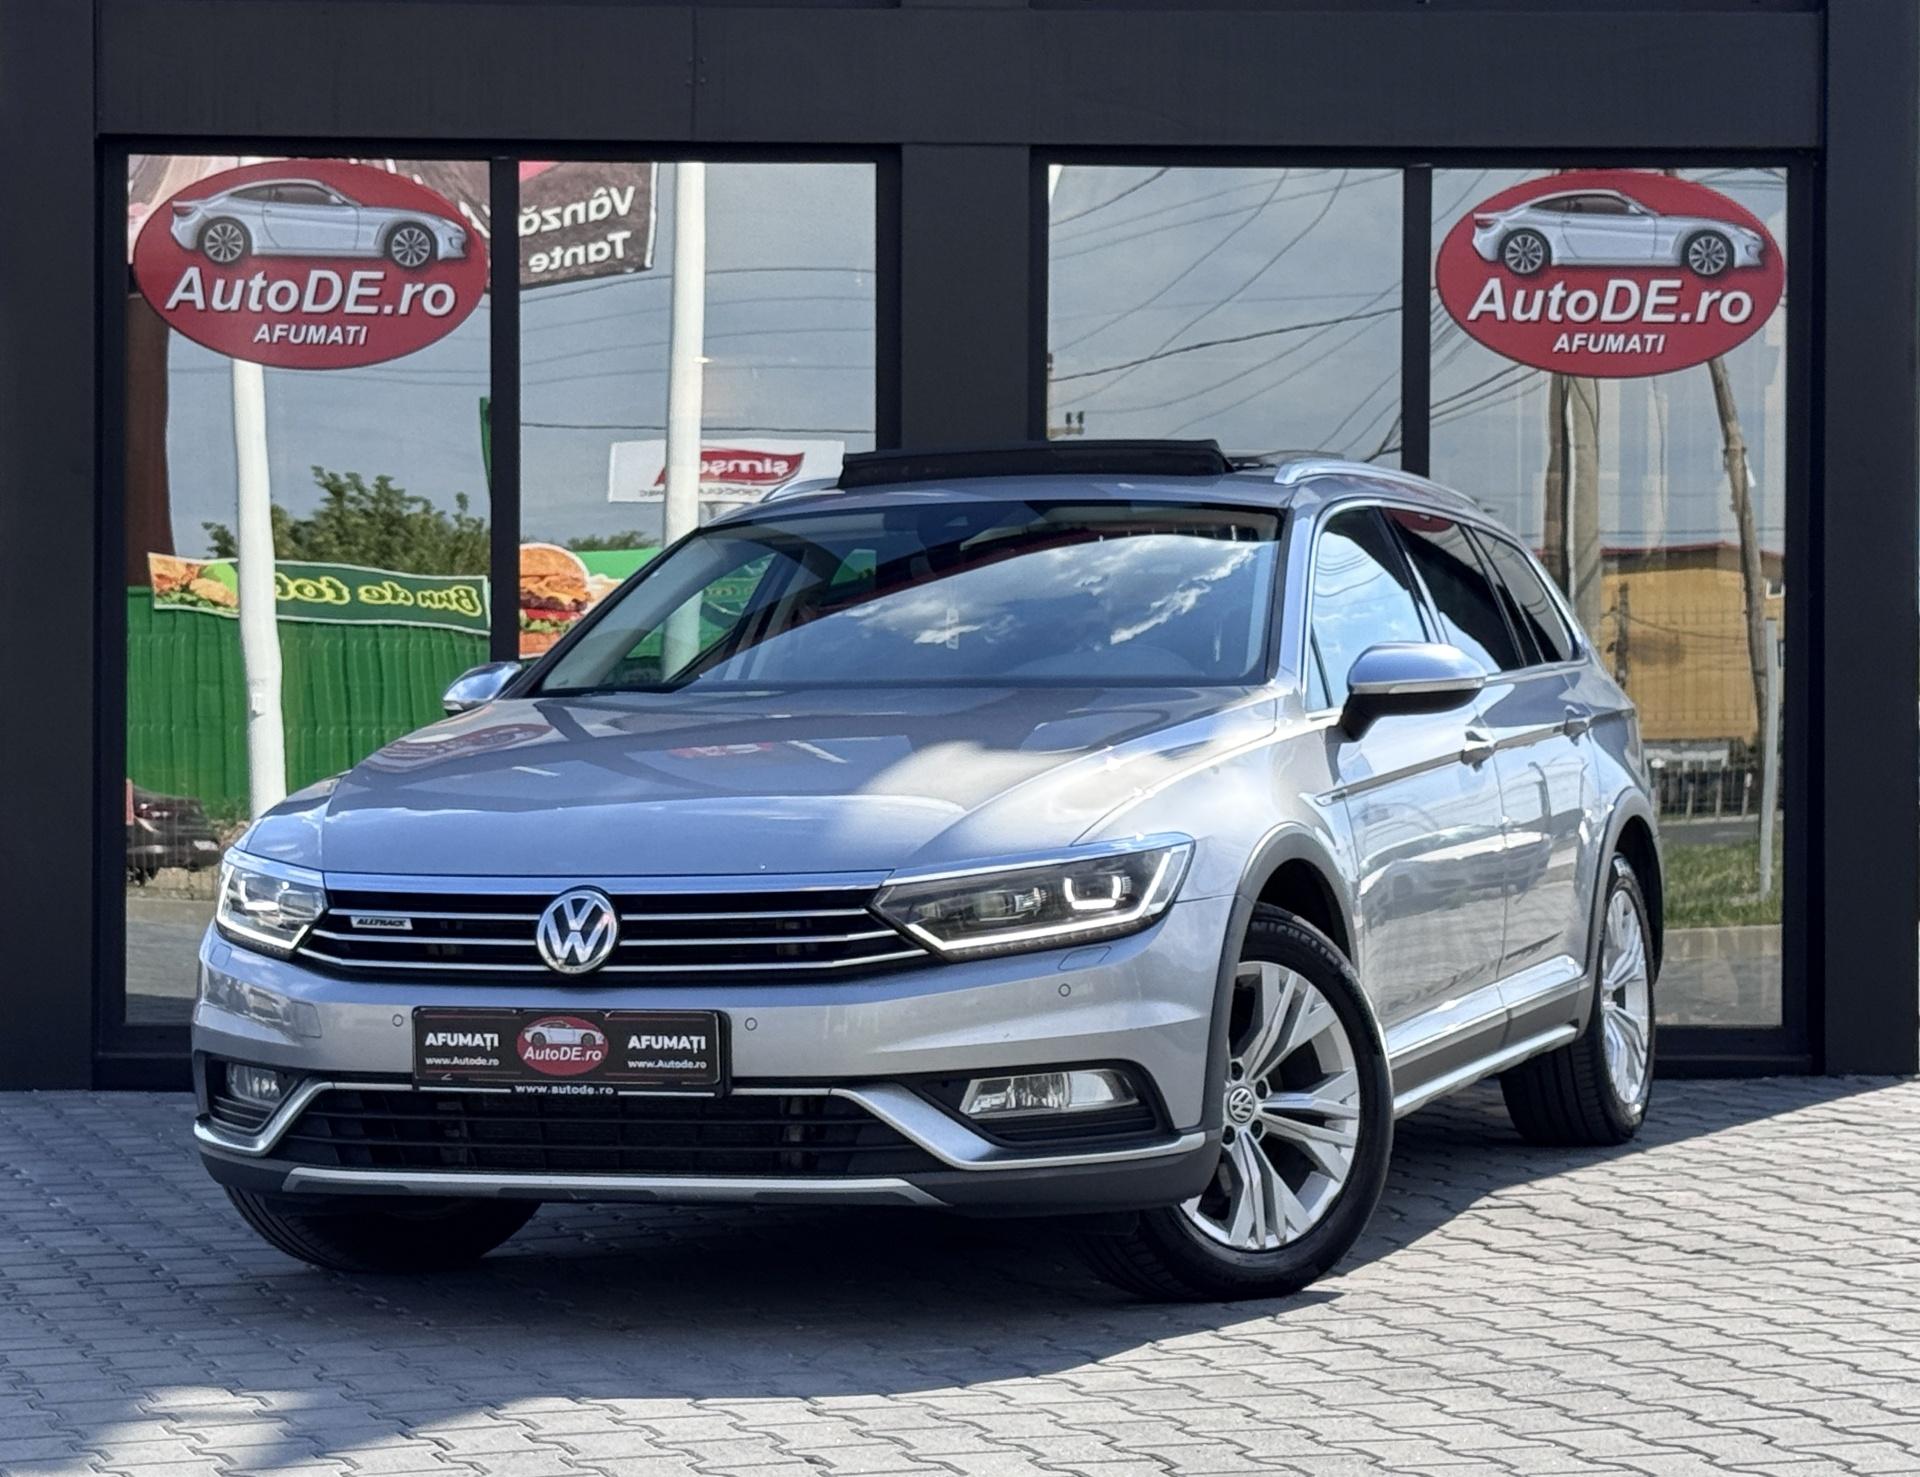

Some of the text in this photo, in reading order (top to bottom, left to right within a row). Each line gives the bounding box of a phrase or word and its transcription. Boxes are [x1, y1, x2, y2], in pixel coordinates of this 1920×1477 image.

[165, 266, 456, 317] AutoDE.ro
[1466, 277, 1754, 324] AutoDE.ro
[253, 323, 369, 346] AFUMATI
[1552, 333, 1666, 354] AFUMATI
[425, 1056, 500, 1066] www.Autode.ro
[523, 1046, 603, 1062] AutoDE.ro
[627, 1059, 707, 1069] www.Autode.ro
[515, 1083, 614, 1096] www.autode.ro
